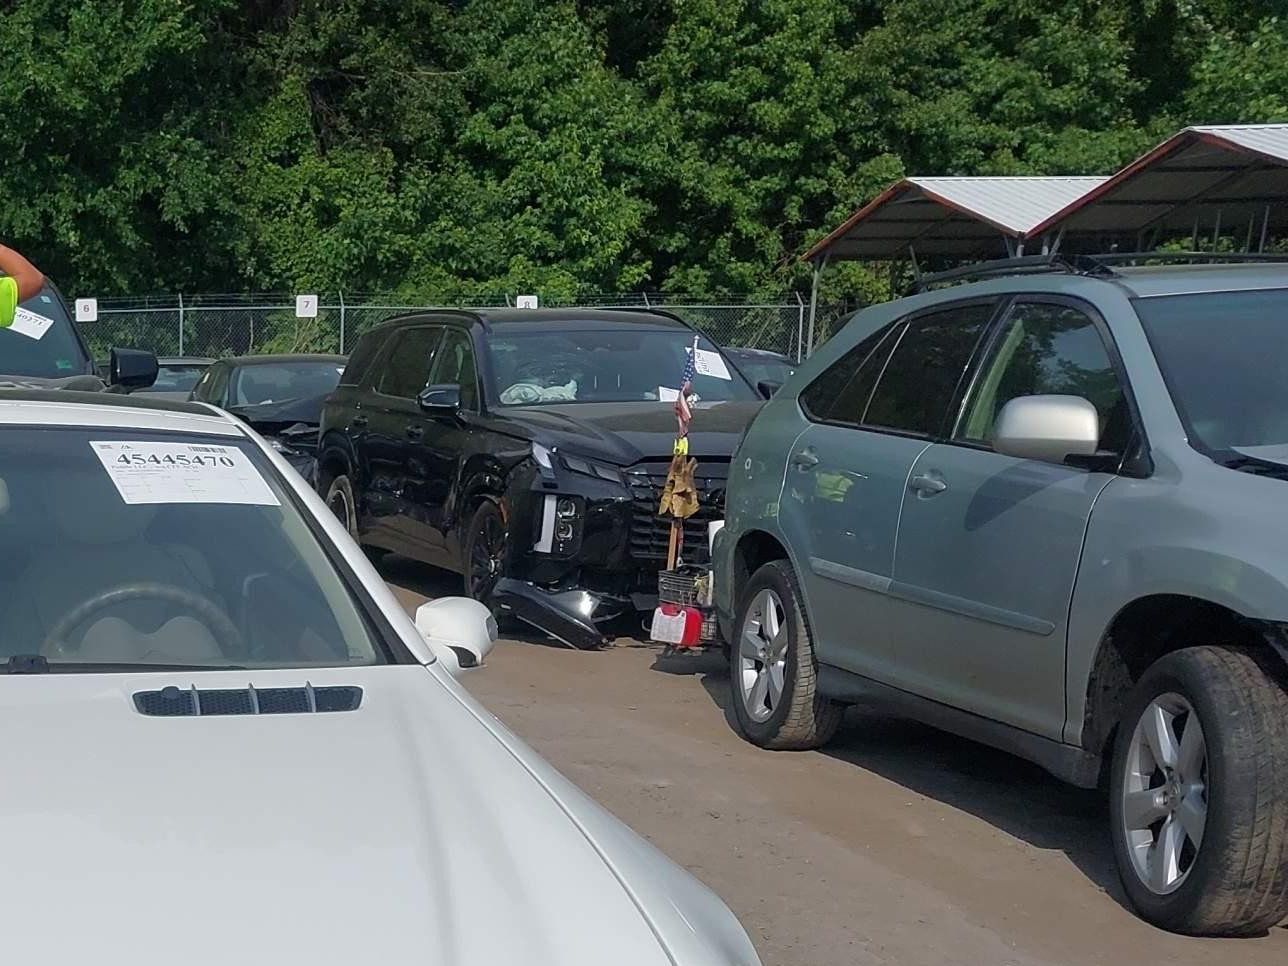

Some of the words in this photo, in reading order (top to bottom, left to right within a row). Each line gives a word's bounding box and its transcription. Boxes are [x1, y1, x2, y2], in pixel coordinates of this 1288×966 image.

[83, 304, 90, 313] 6
[303, 300, 311, 309] 7
[117, 453, 234, 468] 45445470
